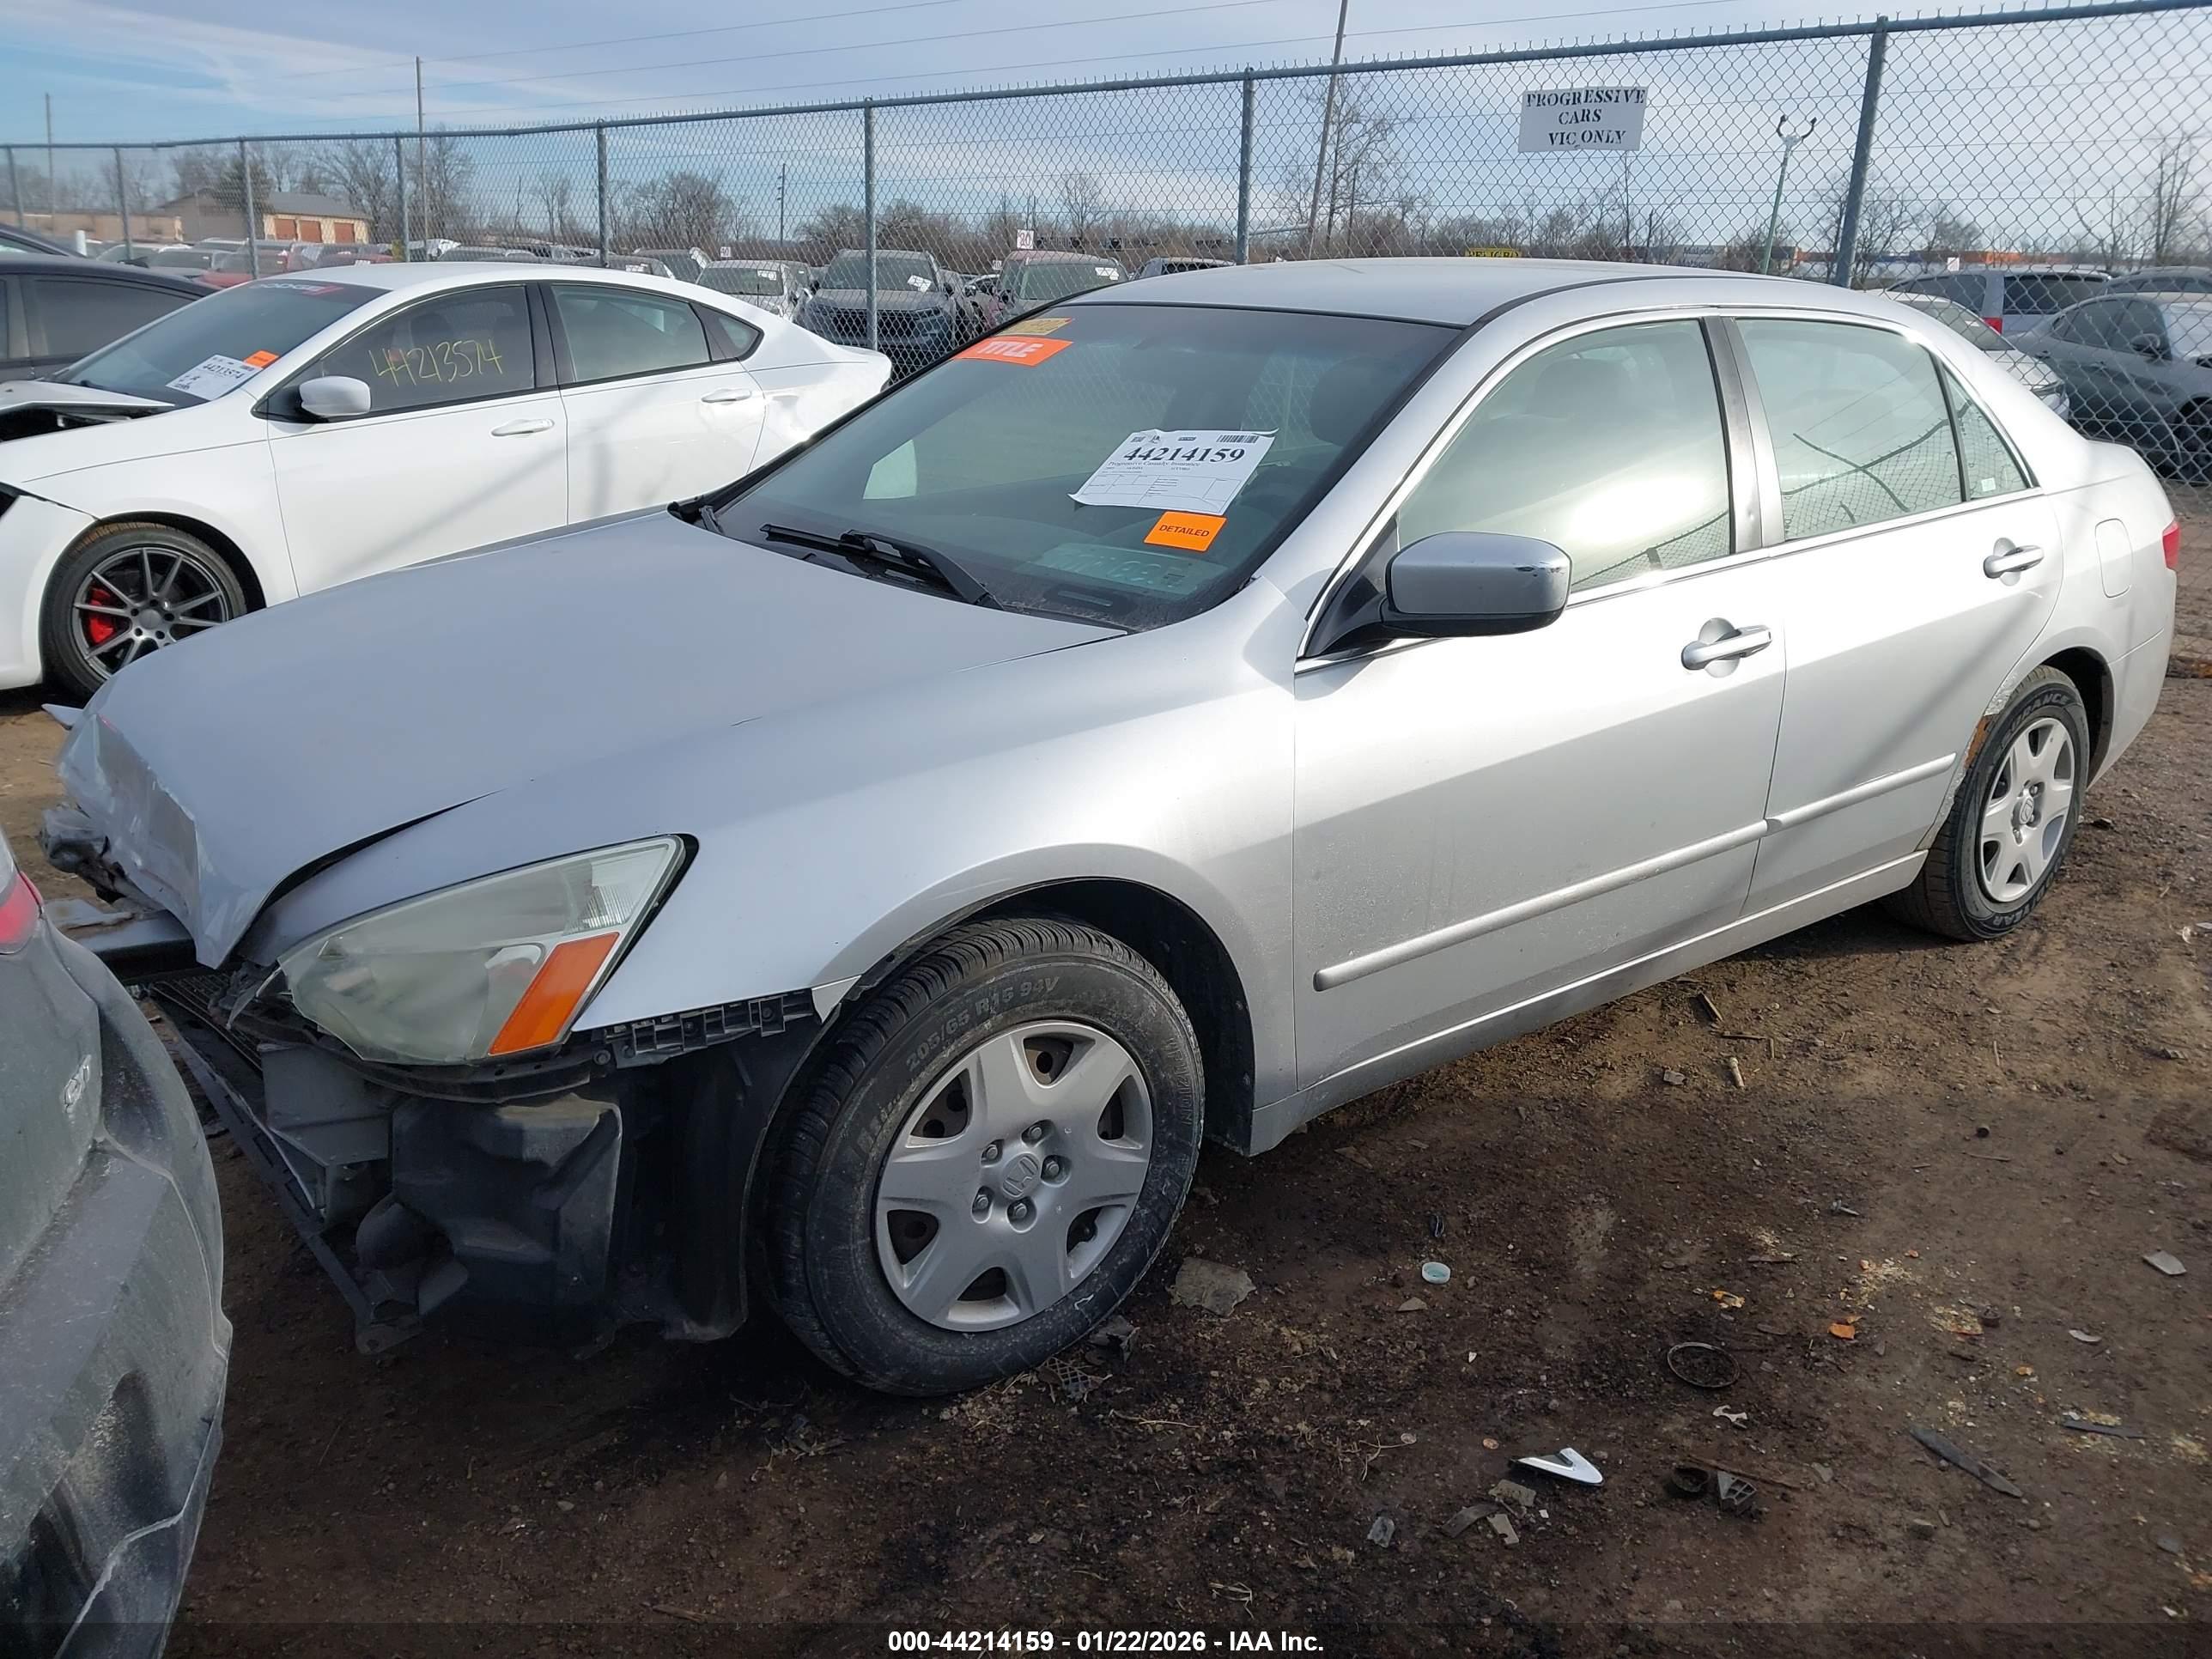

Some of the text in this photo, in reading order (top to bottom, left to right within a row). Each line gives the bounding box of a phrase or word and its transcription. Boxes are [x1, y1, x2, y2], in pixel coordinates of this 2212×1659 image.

[1525, 88, 1646, 107] PROGRESSIVE
[1559, 108, 1602, 125] CARS
[1548, 130, 1626, 146] VIC ONLY
[976, 341, 1044, 358] TITLE
[368, 338, 502, 387] 44213574
[1123, 447, 1245, 463] 44214159
[1159, 525, 1210, 538] DETAILED
[906, 976, 1060, 1072] 205/65 R15 94V
